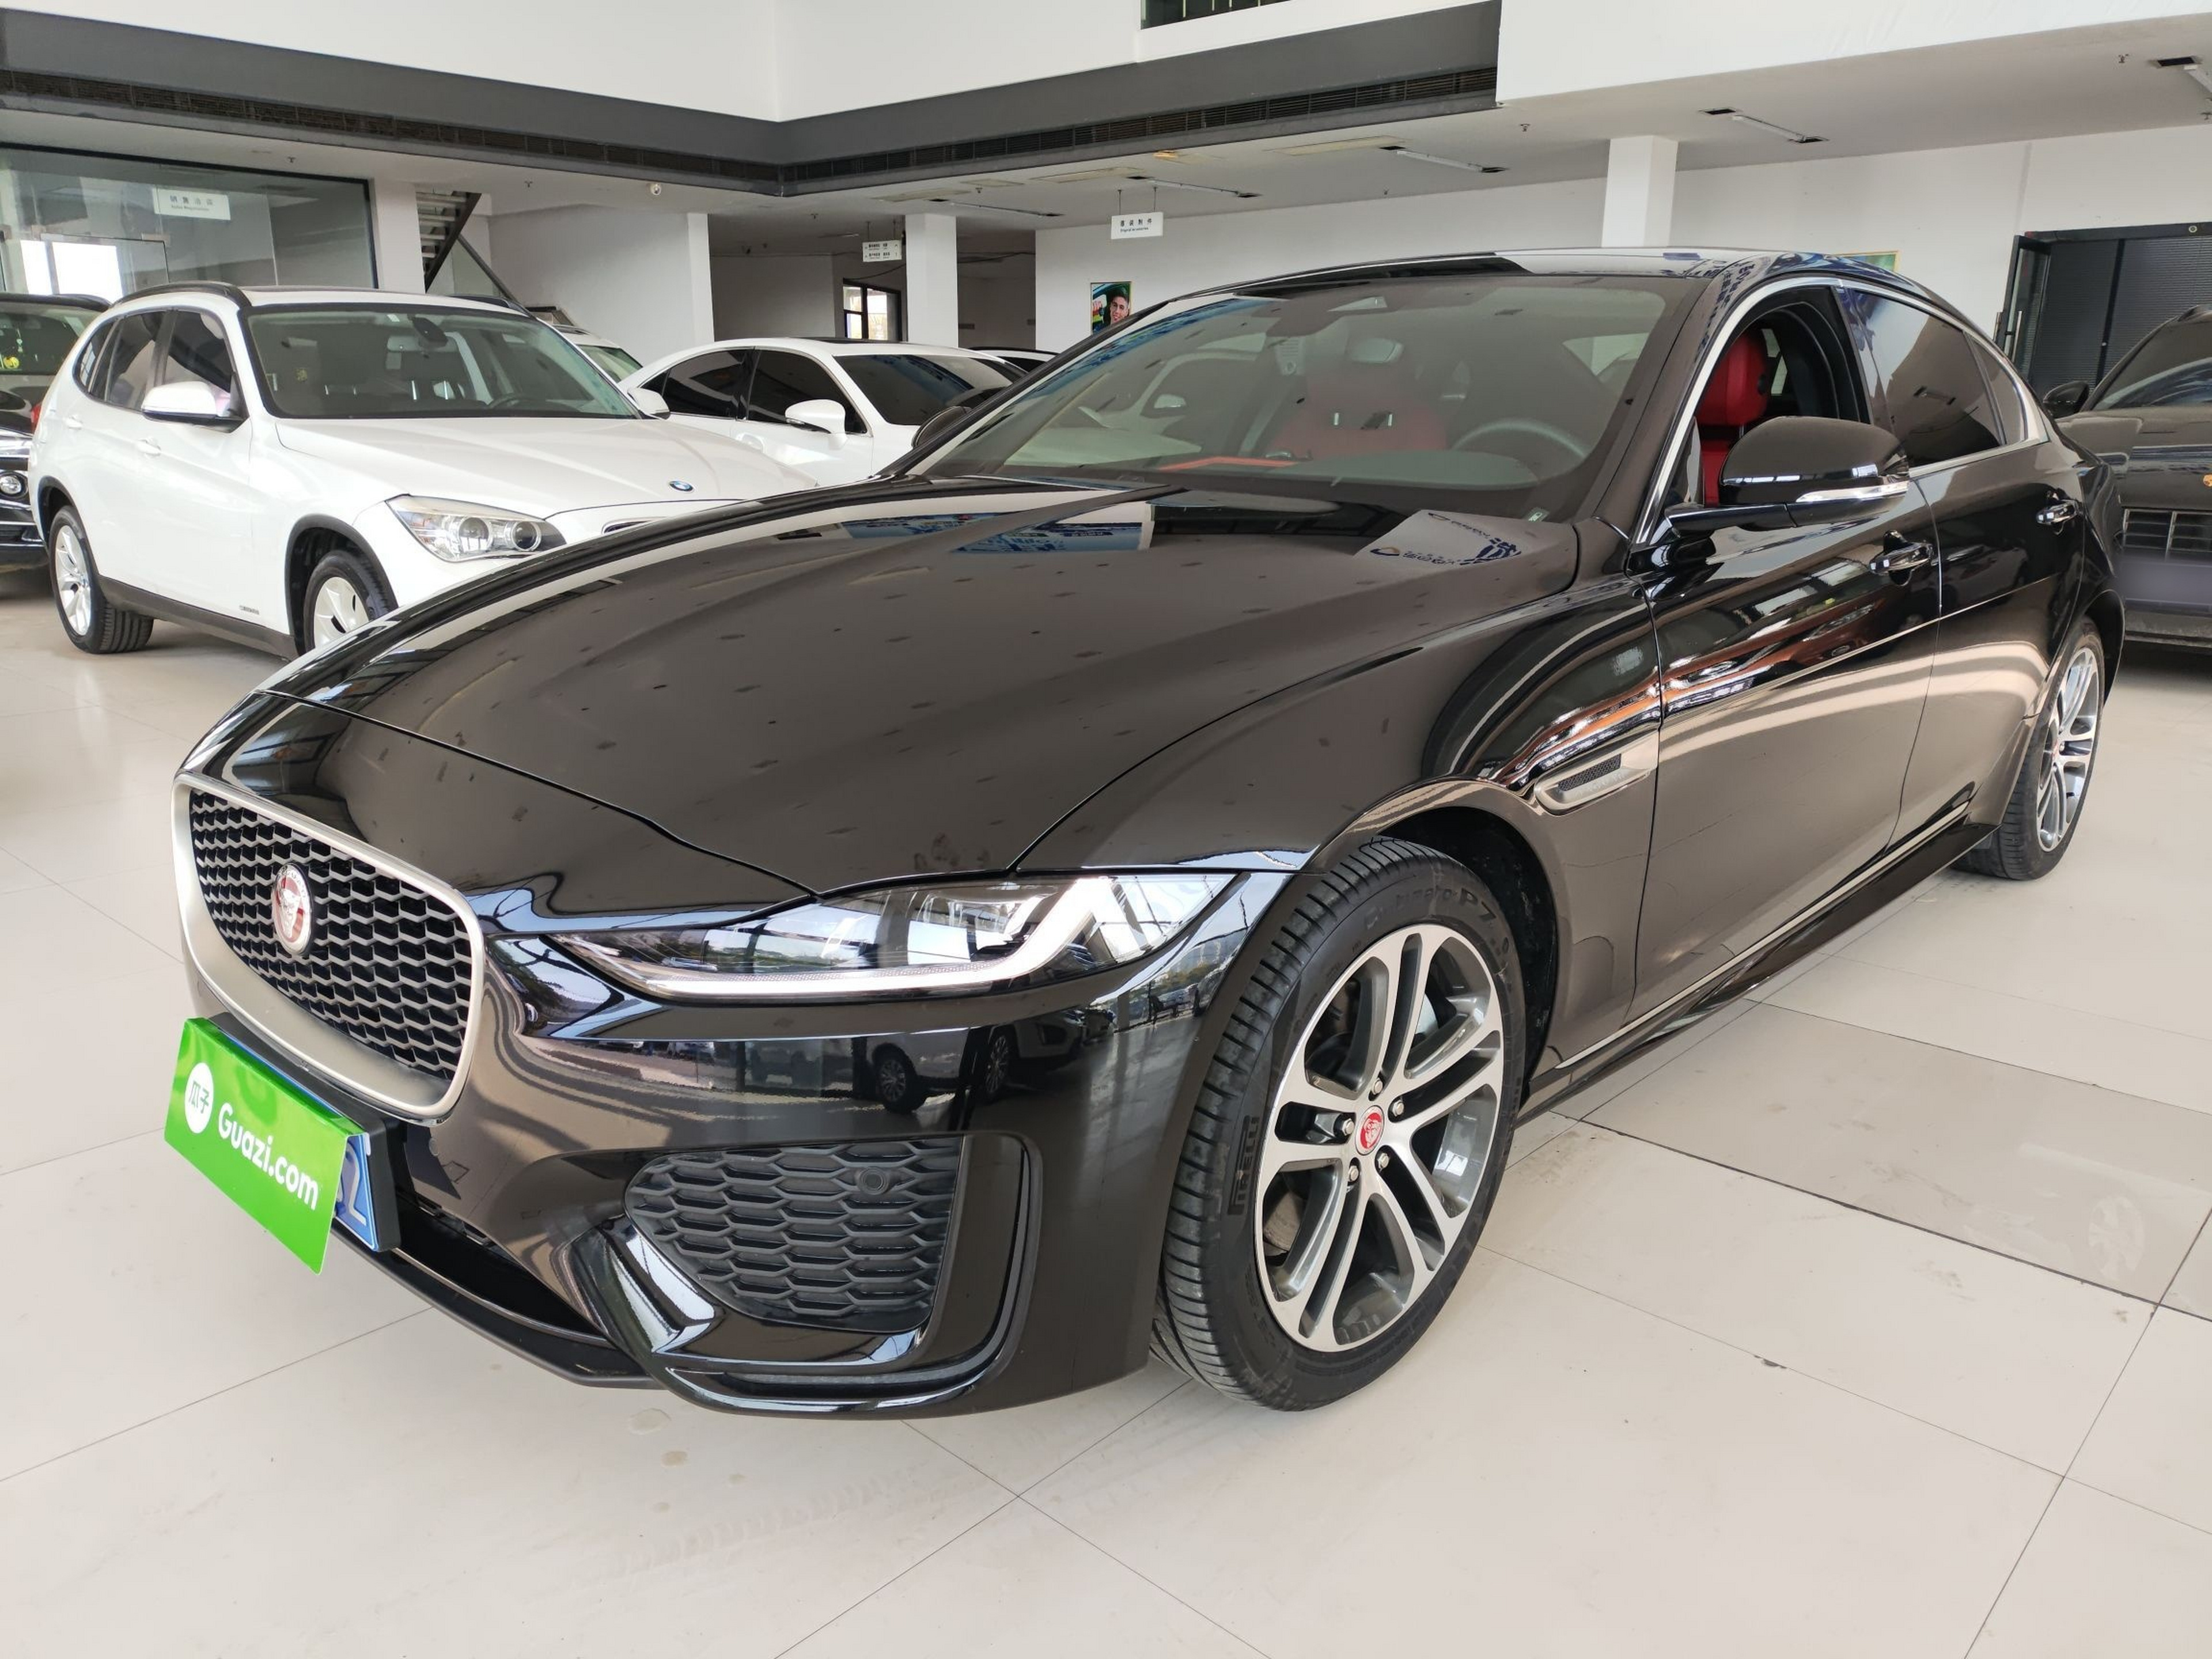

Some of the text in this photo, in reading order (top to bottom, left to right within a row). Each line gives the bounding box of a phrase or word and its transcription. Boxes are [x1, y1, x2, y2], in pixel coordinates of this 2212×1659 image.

[188, 1081, 209, 1114] 瓜子
[218, 1103, 319, 1211] Guazi.com
[1228, 1115, 1260, 1215] PIRELLI
